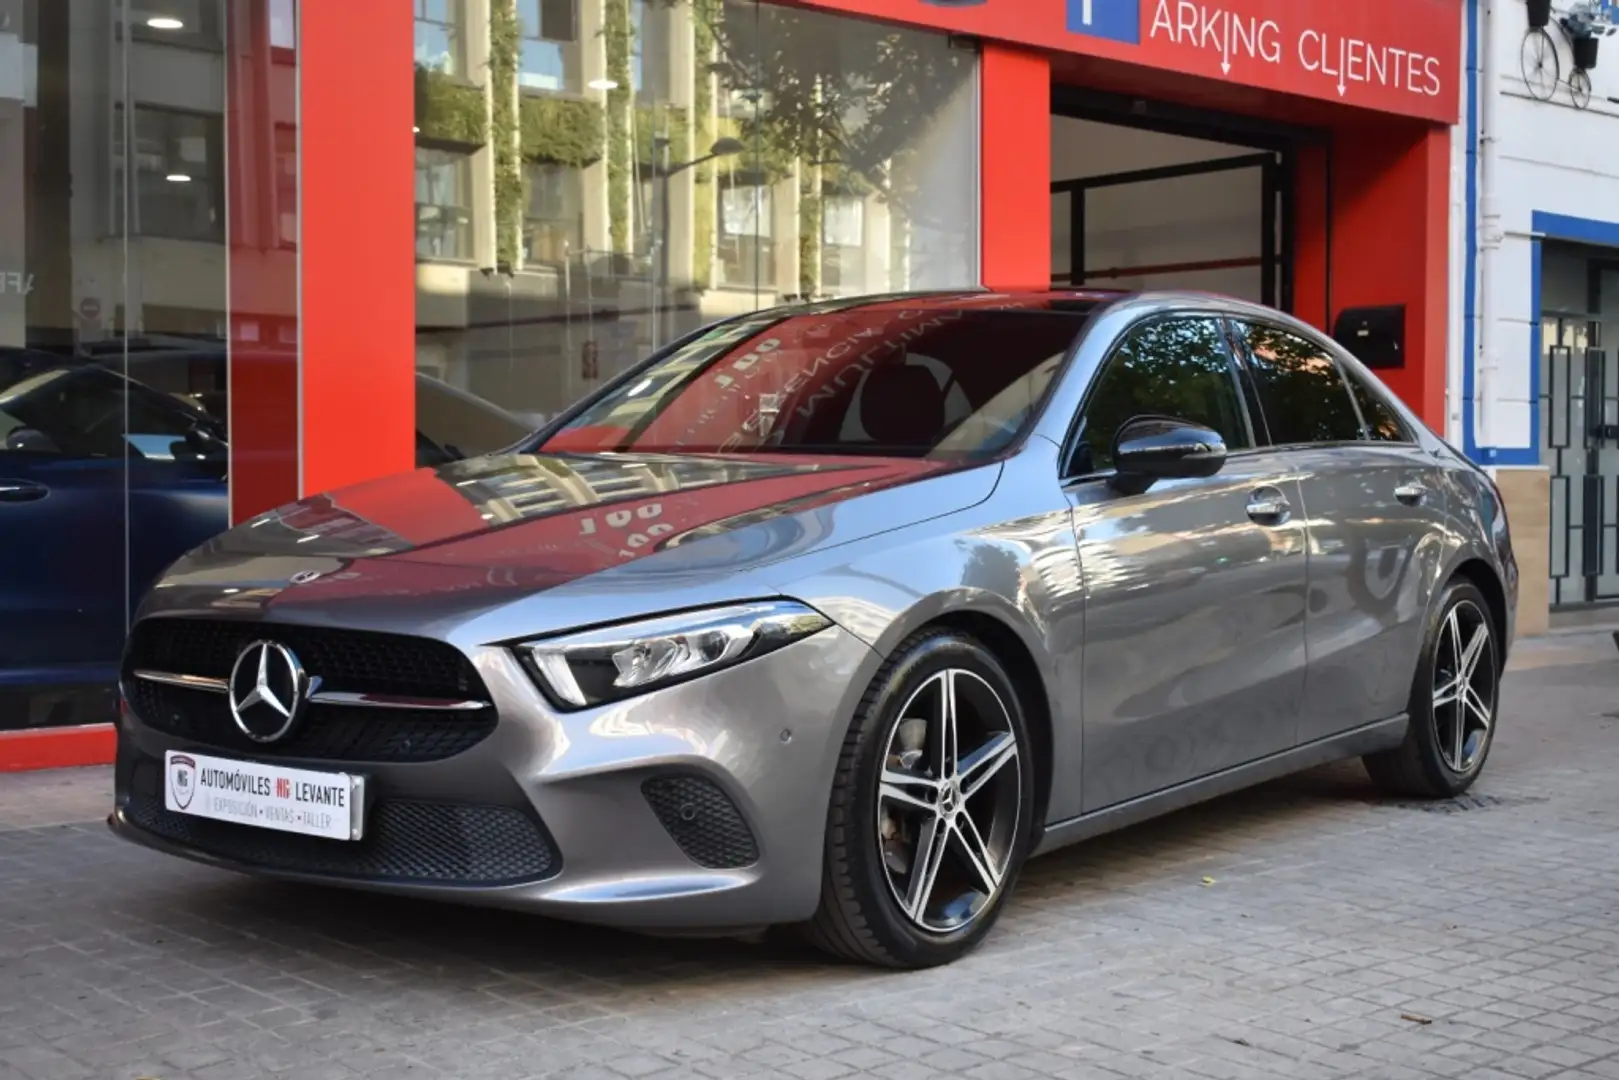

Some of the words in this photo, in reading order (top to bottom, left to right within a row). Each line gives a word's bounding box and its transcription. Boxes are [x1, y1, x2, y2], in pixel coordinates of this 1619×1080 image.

[1082, 0, 1280, 75] ARKING
[1298, 29, 1440, 97] CLIENTES
[200, 767, 271, 797] AUTOMÓVILES
[295, 780, 346, 808] LEVANTE
[264, 804, 295, 825] VENTAS
[303, 810, 332, 830] TALLER
